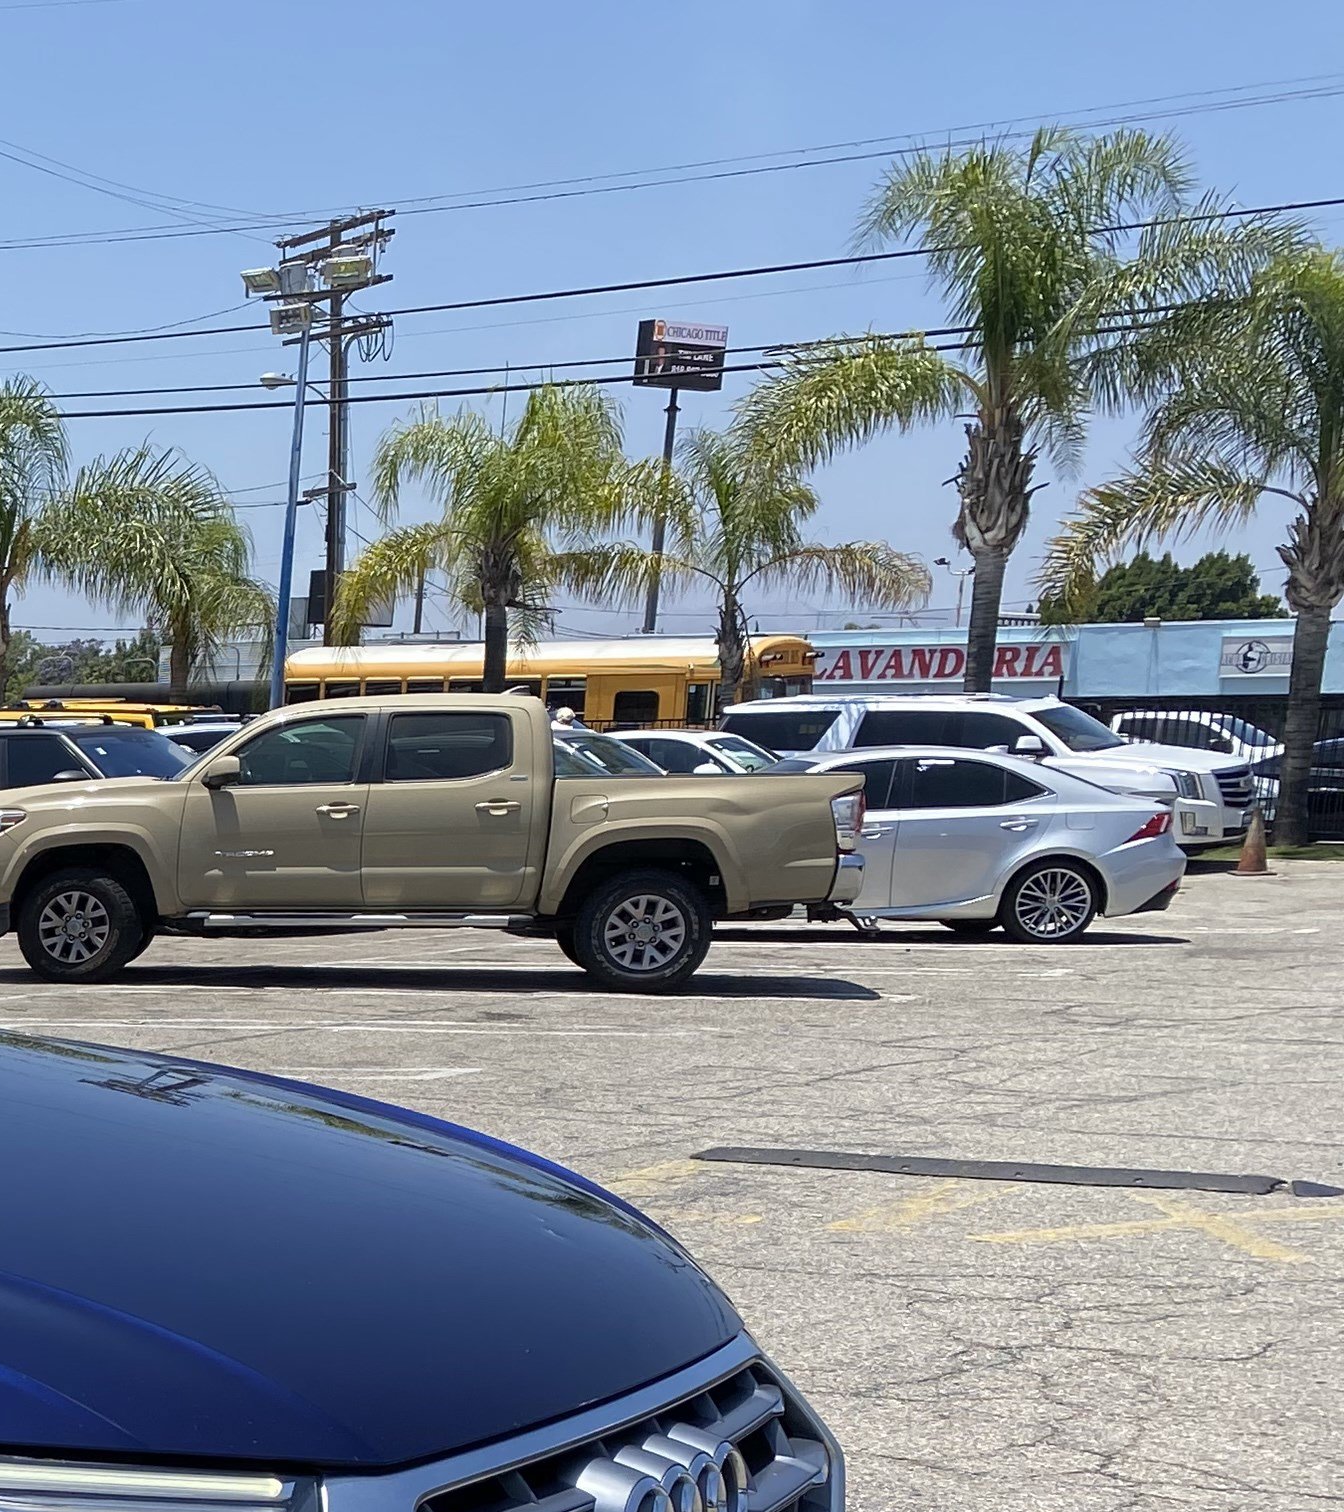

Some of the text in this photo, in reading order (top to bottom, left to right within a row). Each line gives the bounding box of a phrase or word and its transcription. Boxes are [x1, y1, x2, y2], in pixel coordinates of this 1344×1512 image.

[667, 326, 727, 341] CHICAGO TITLE
[813, 646, 1064, 679] AVANDRIA
